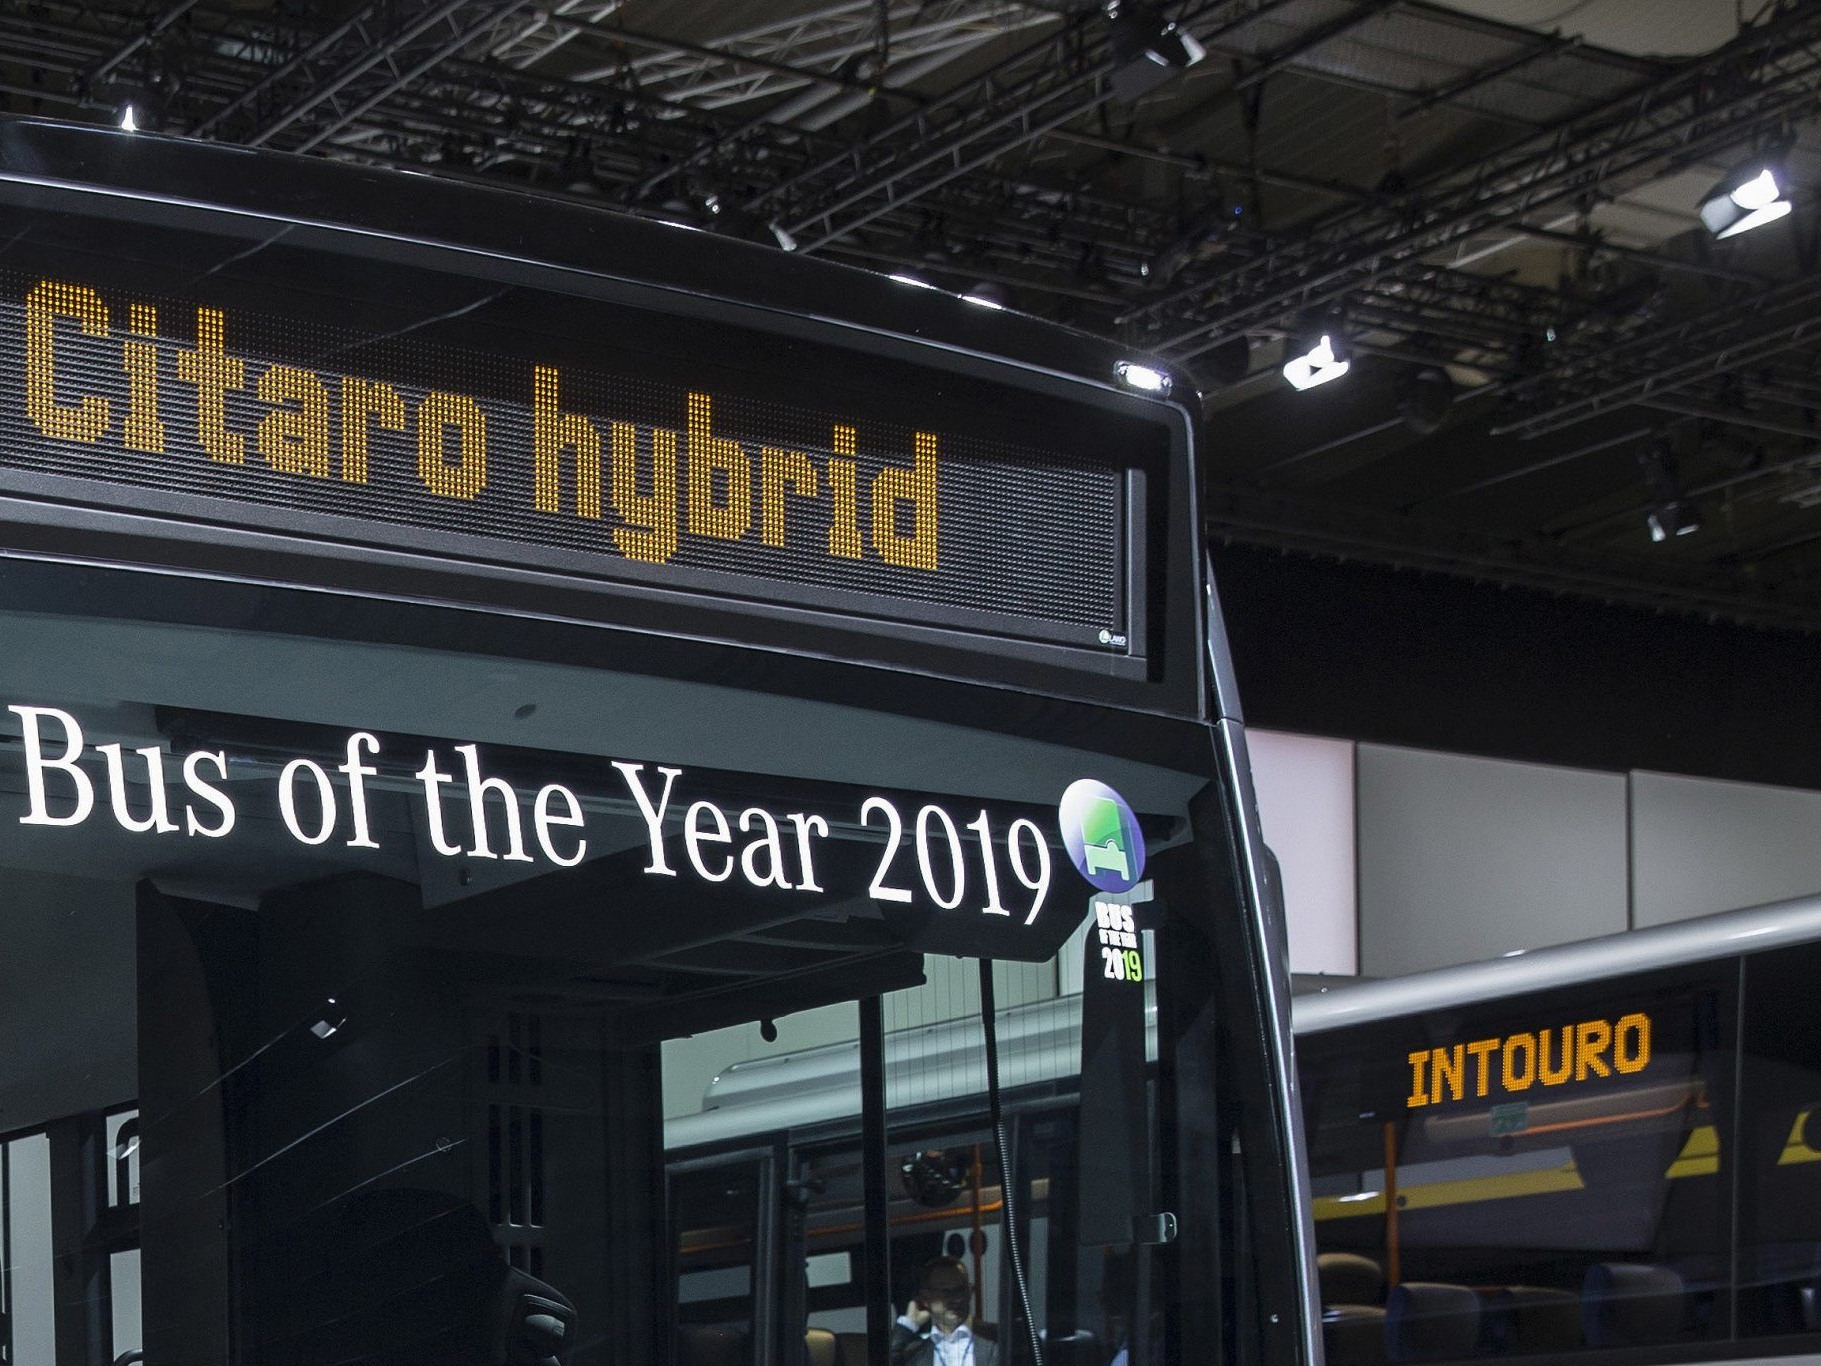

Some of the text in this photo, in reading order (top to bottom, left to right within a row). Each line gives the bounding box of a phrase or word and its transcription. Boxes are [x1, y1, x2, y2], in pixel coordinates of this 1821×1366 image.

[26, 280, 937, 570] Citaro hybrid
[8, 704, 1051, 926] Bus of the Year 2019
[1094, 901, 1135, 934] BUS
[1102, 946, 1143, 982] 2019
[1406, 1012, 1652, 1108] INTOURO
